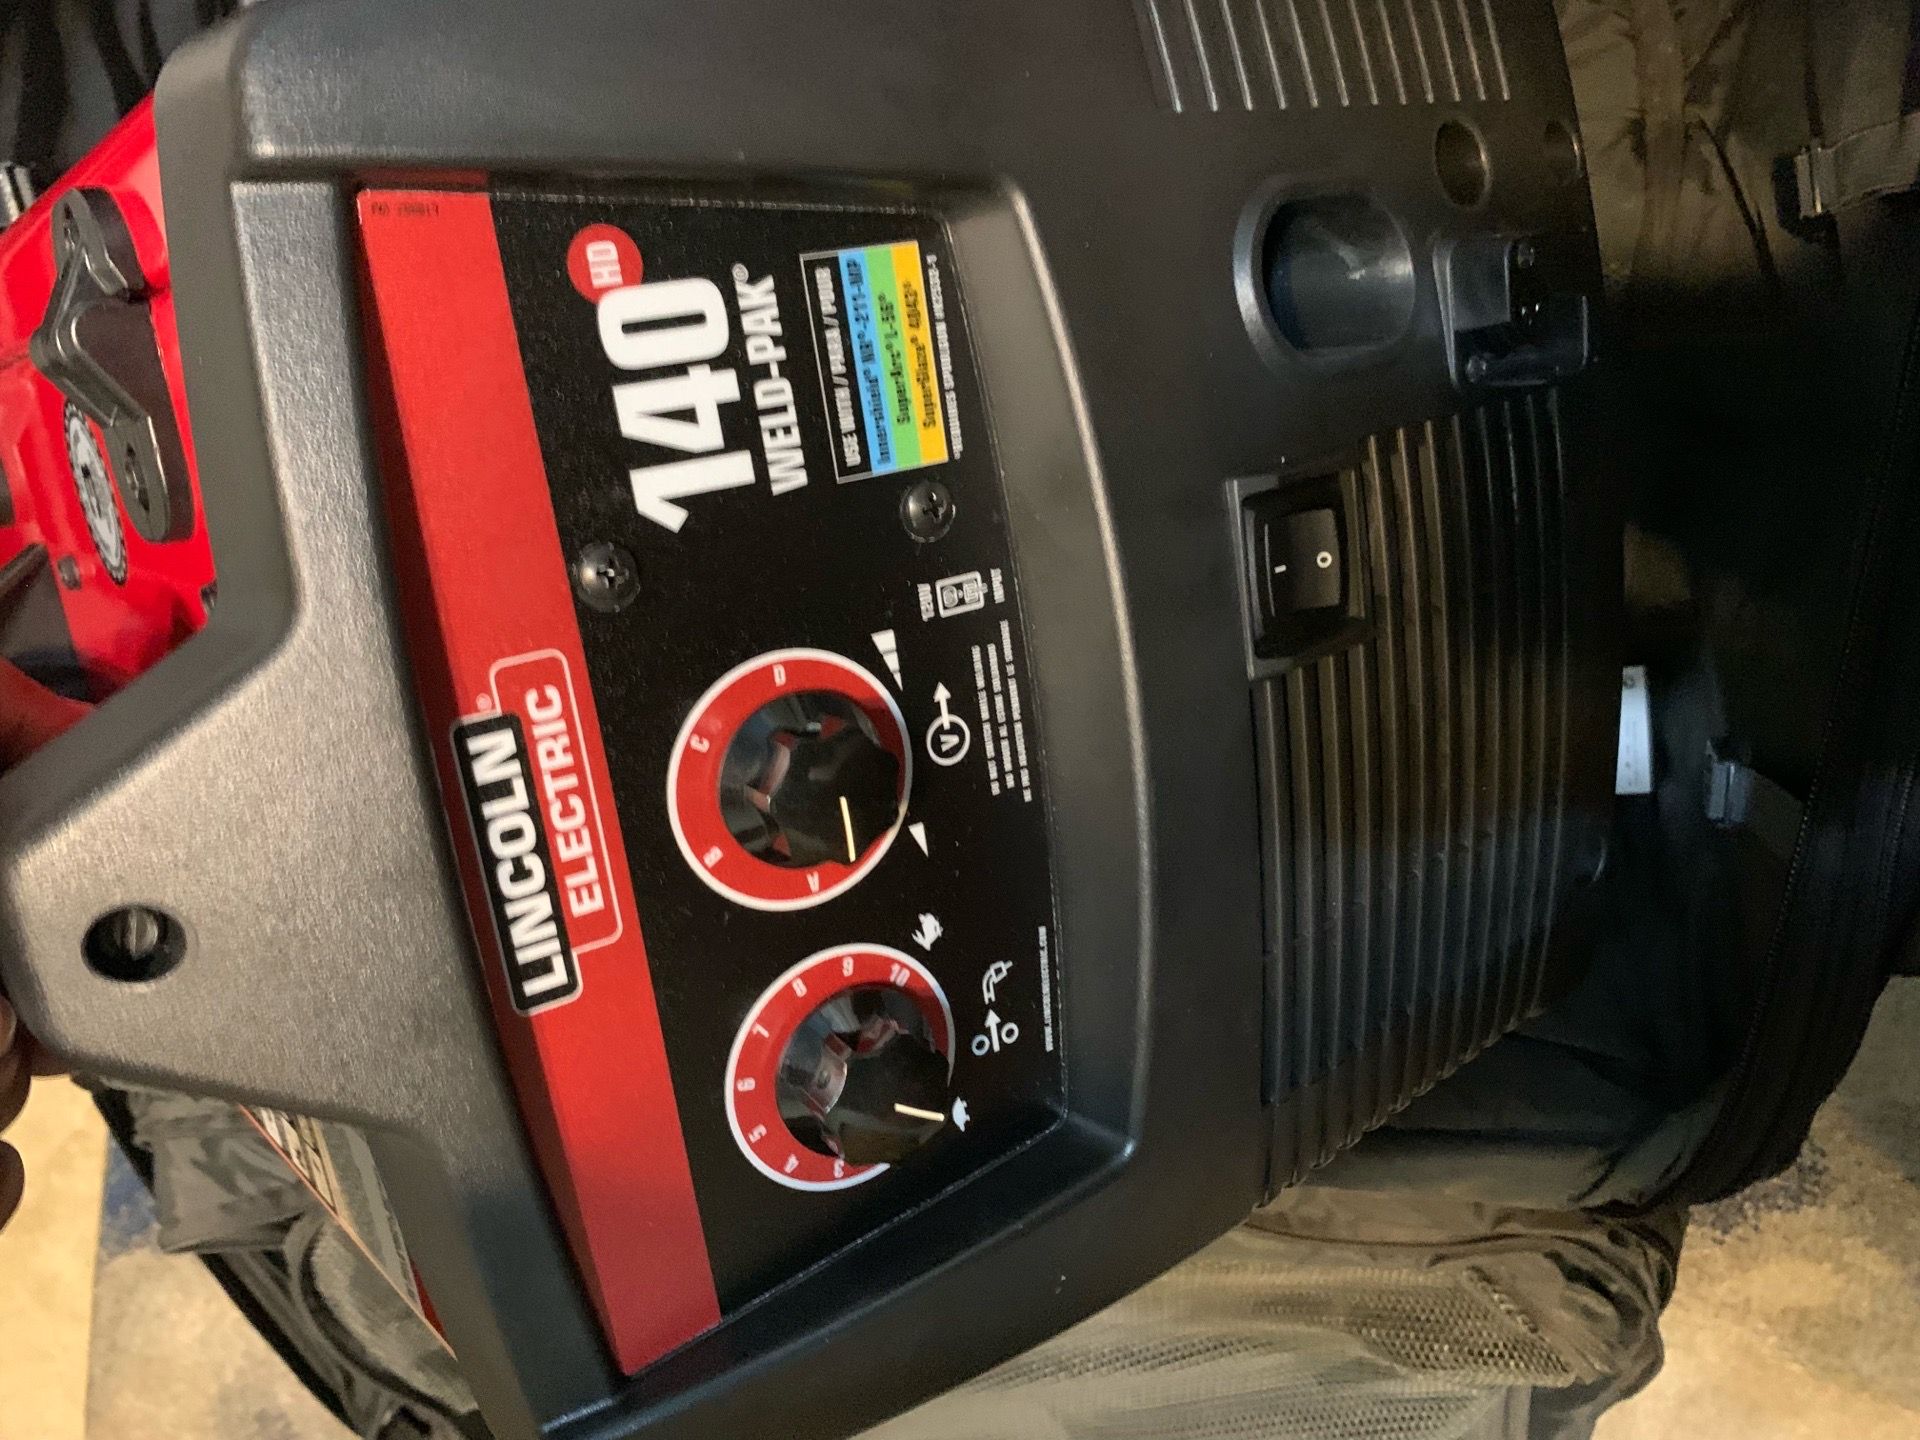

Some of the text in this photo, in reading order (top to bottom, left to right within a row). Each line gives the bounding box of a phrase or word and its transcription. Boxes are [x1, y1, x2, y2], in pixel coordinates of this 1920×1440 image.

[586, 240, 623, 289] HD
[597, 277, 755, 533] 140
[842, 432, 861, 467] USE
[772, 664, 787, 687] D
[690, 734, 710, 753] C
[525, 684, 605, 918] ELECTRIC
[466, 727, 568, 998] LINCOLN
[806, 871, 819, 893] A
[843, 956, 854, 977] 9
[890, 963, 910, 987] 10
[752, 1023, 769, 1038] 7
[737, 1077, 755, 1091] 6
[750, 1124, 767, 1143] 5
[784, 1154, 799, 1174] 4
